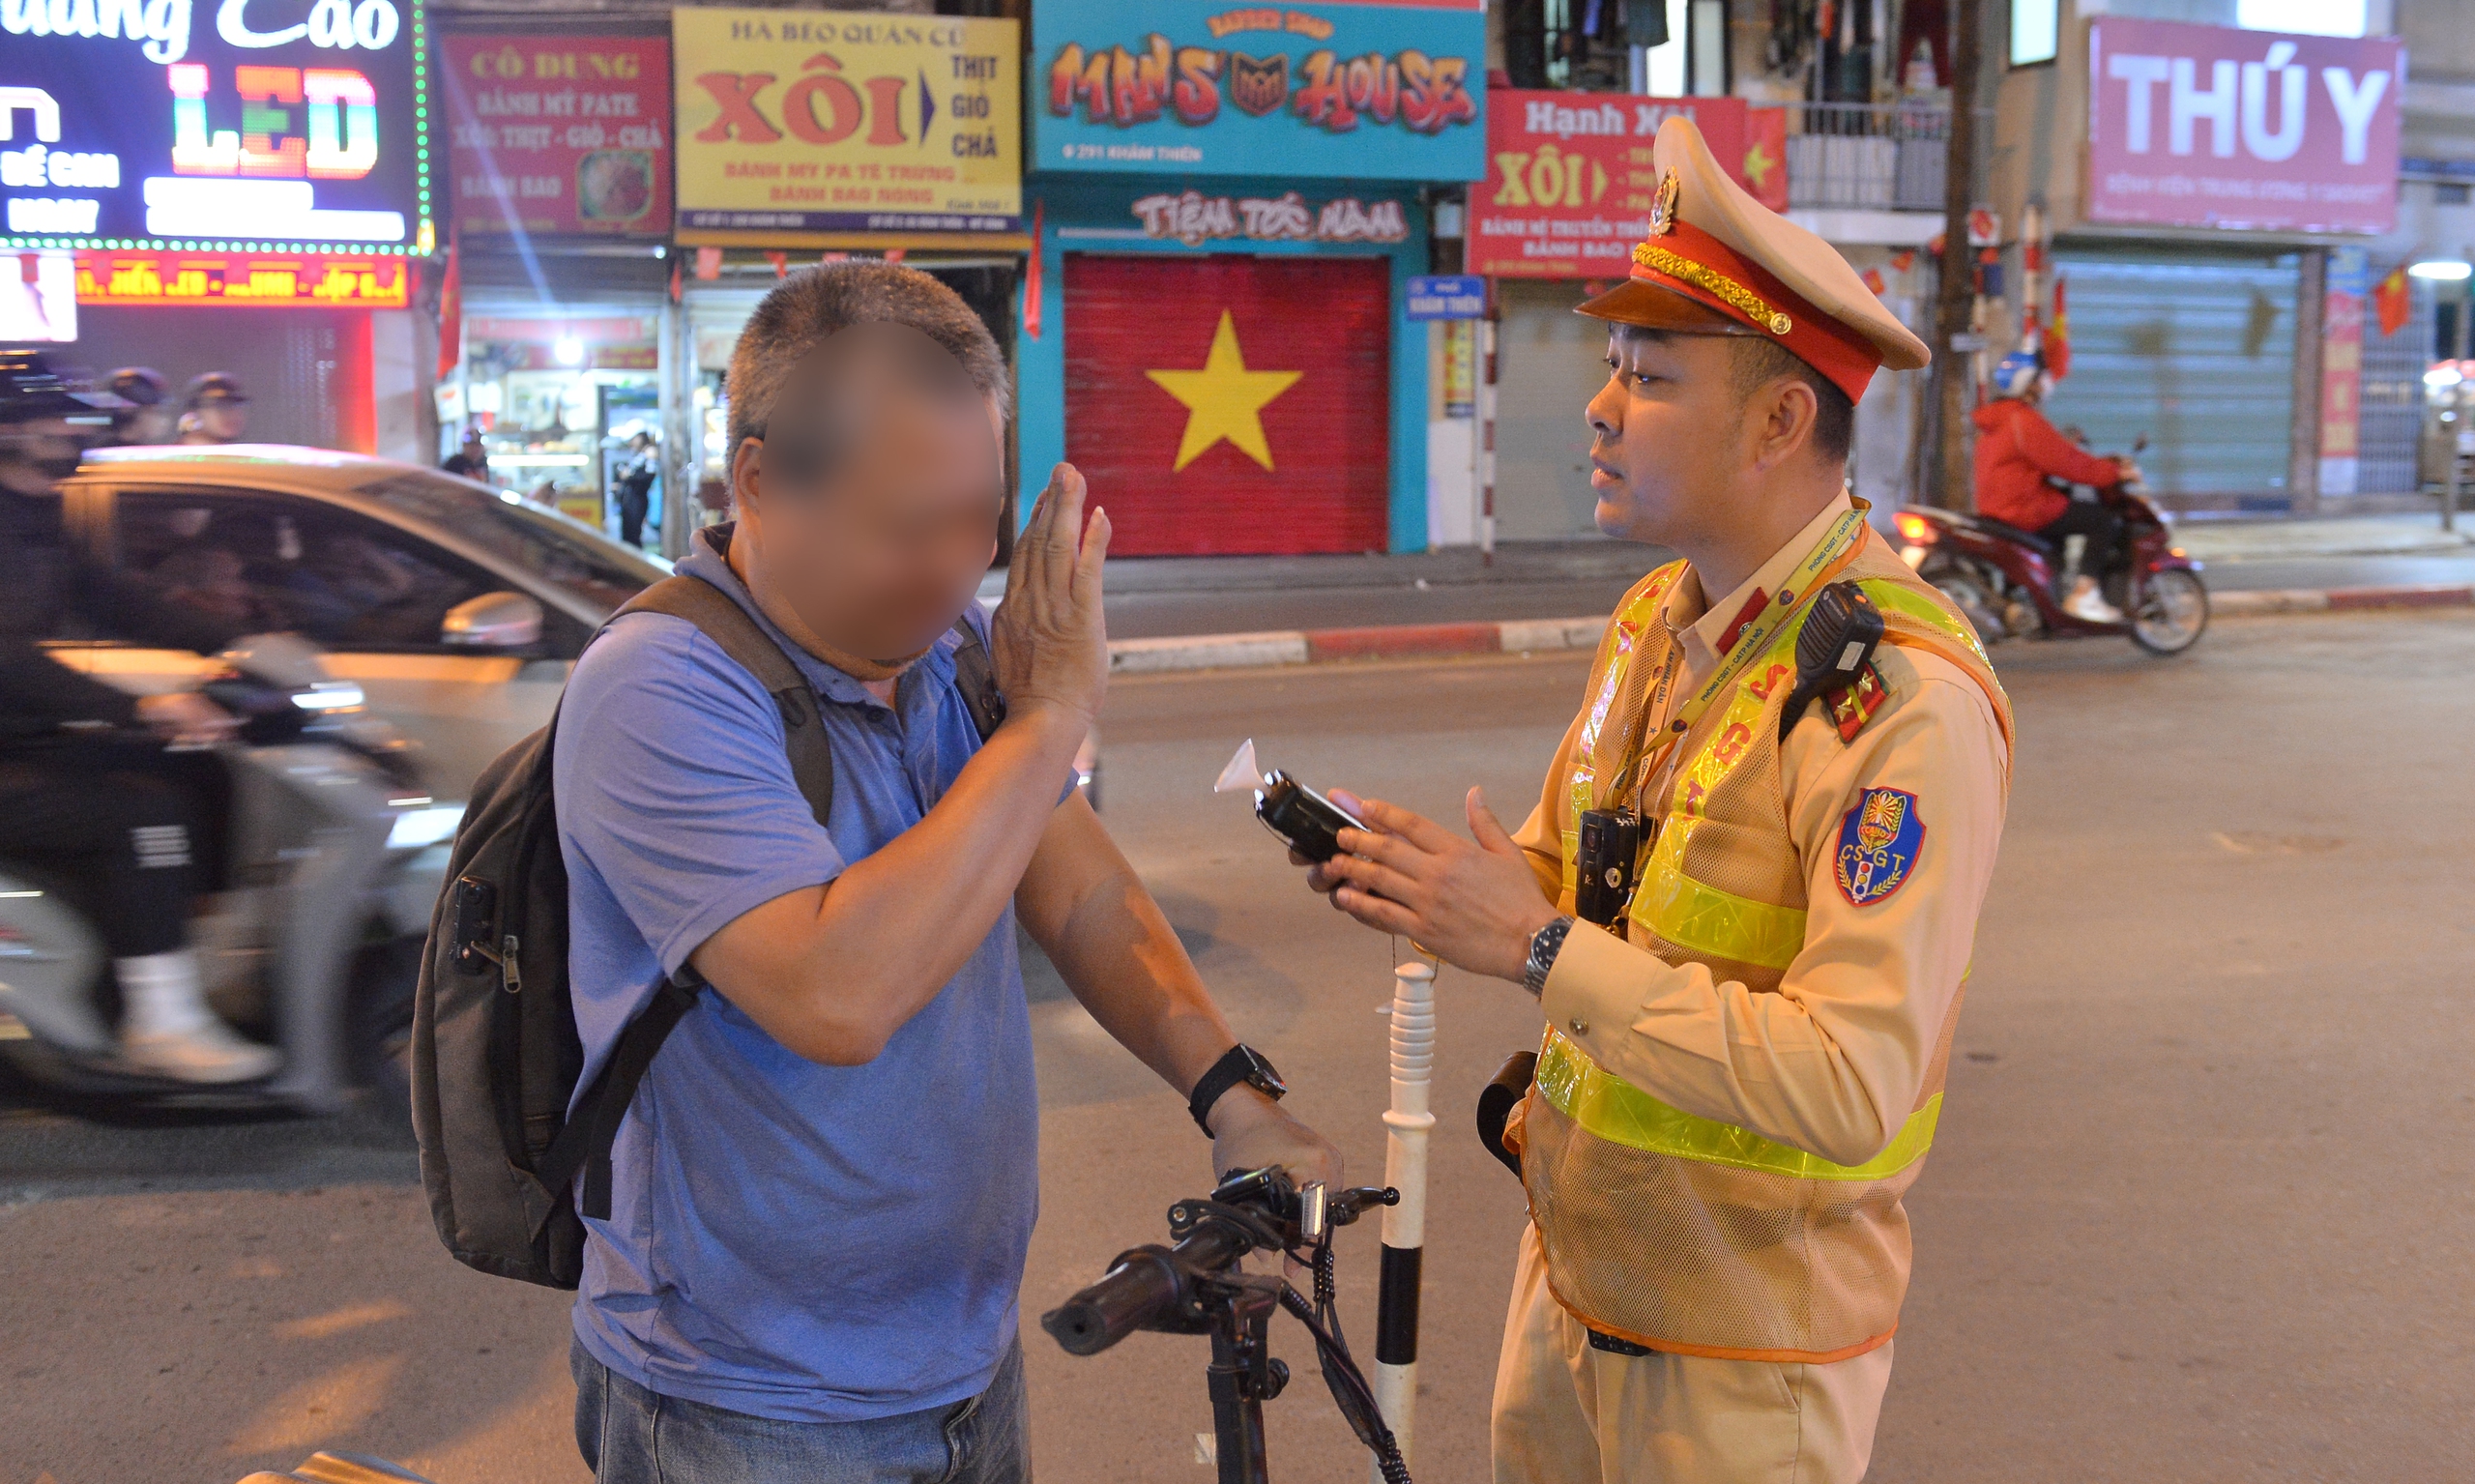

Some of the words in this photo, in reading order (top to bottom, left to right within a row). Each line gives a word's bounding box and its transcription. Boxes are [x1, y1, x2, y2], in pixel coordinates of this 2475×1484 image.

[471, 44, 525, 79] CÔ
[951, 54, 997, 84] THỊT
[693, 51, 908, 147] XÔI
[1293, 49, 1477, 135] HOUSE
[2108, 41, 2309, 162] THÚ
[2321, 66, 2393, 165] Y
[168, 64, 378, 179] LED
[1525, 102, 1626, 139] Hạnh
[951, 127, 998, 159] CHẢ
[724, 160, 782, 179] BÁNH
[1492, 144, 1586, 207] XÔI
[770, 185, 827, 202] BÁNH
[831, 187, 871, 203] BAO
[1131, 189, 1238, 247] TIỆM
[1316, 198, 1412, 242] NAM
[1662, 661, 1673, 685] NHÂN
[1700, 681, 1720, 702] PHÒNG
[1717, 666, 1732, 684] CSGT
[1732, 647, 1748, 664] CATP
[1656, 685, 1667, 704] DÂN
